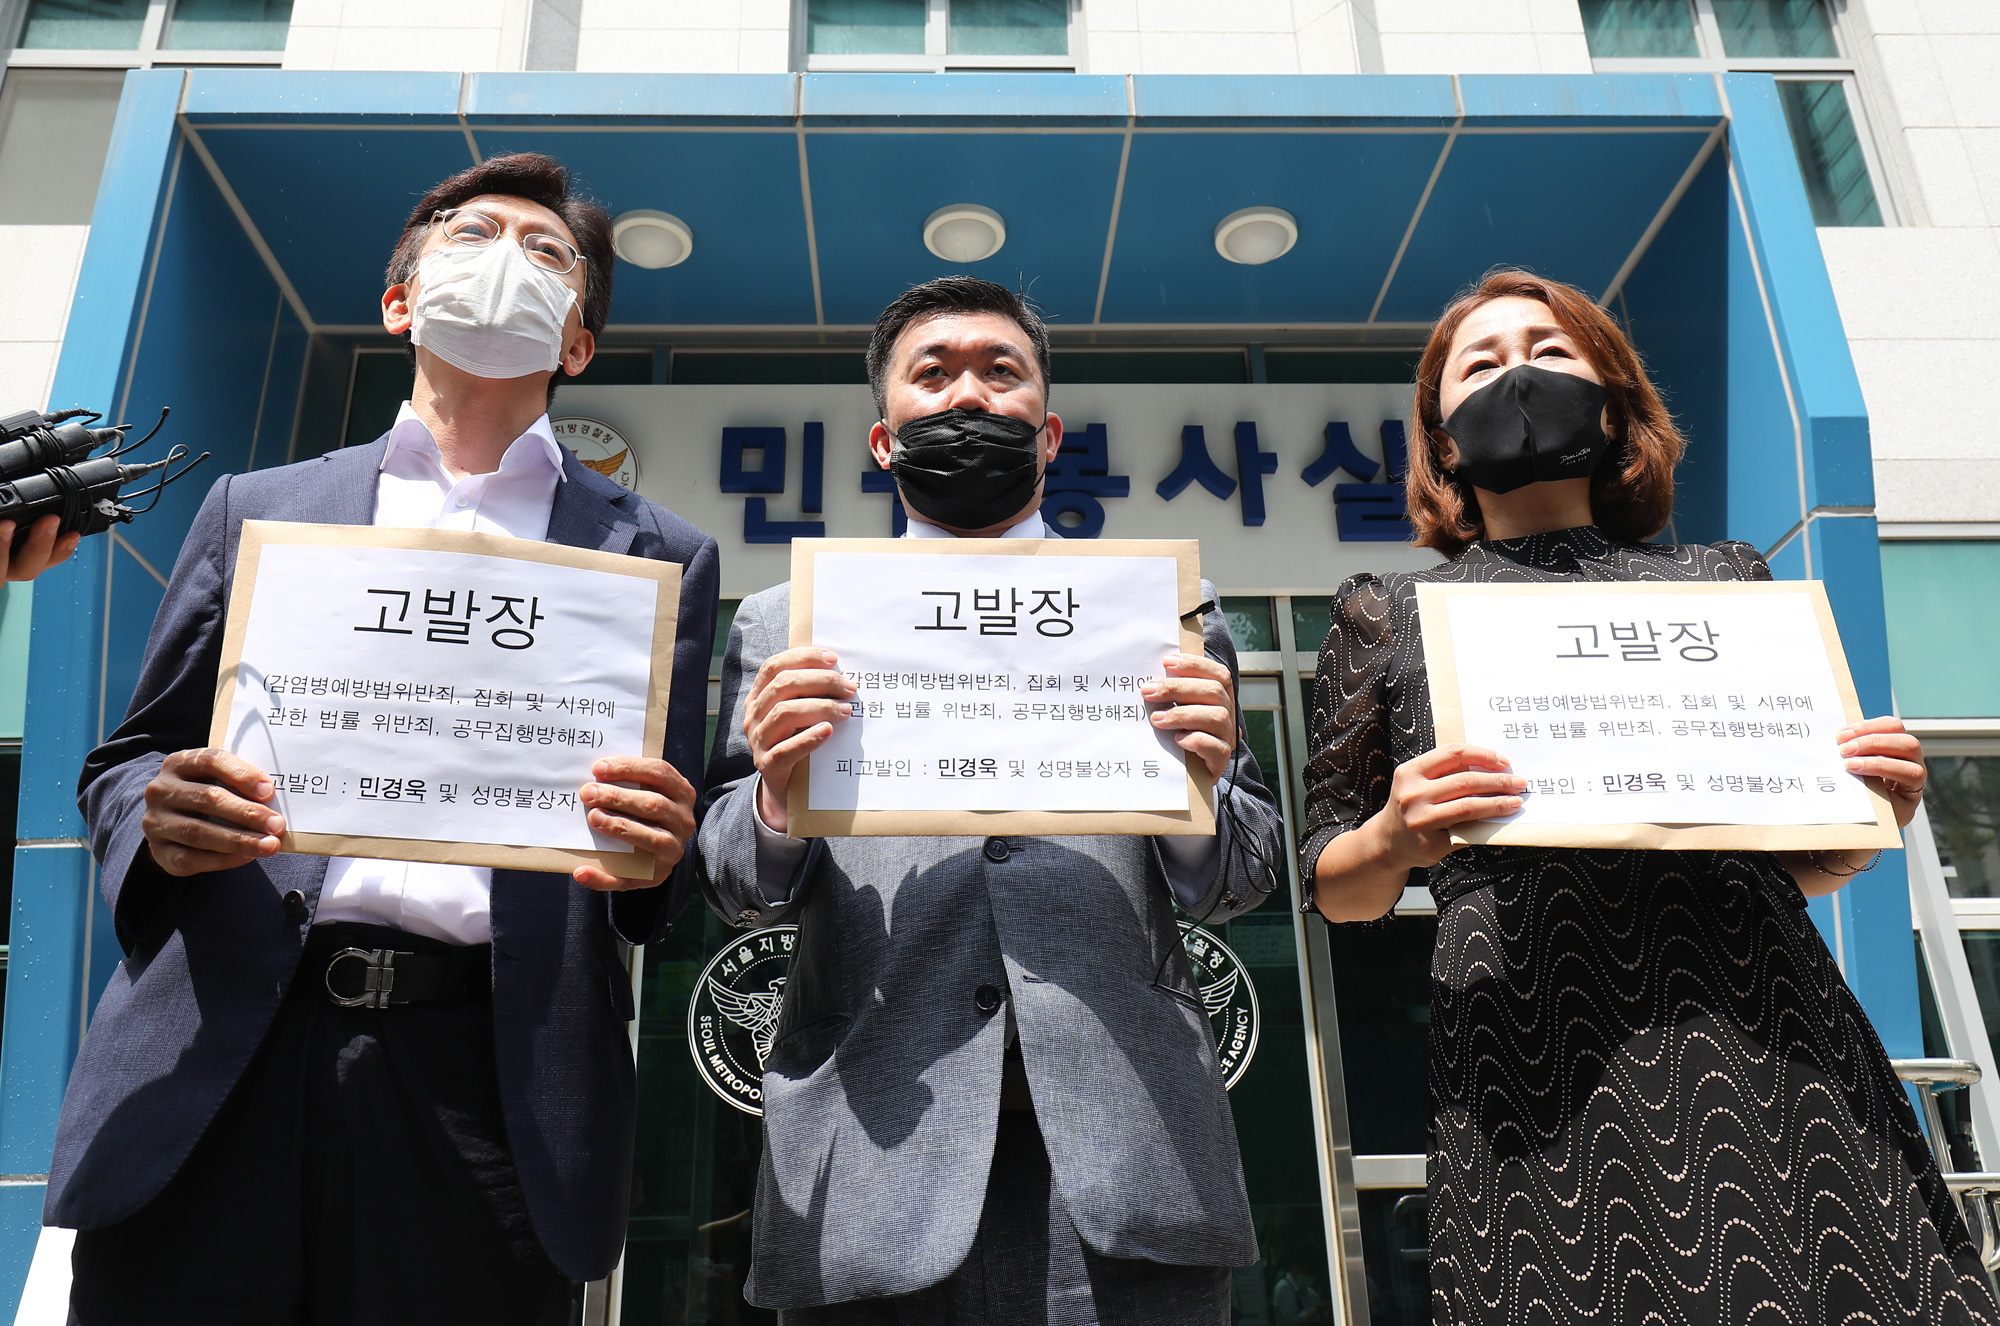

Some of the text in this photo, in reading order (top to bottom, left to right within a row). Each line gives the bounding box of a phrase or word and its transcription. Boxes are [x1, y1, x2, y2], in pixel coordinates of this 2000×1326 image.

[554, 424, 614, 444] 지방경찰청
[719, 420, 1418, 543] 민봉사실
[354, 588, 545, 650] 고발장
[915, 587, 1080, 637] 고발장
[1556, 620, 1720, 662] 고발장
[262, 674, 616, 720] (감염병예방법위반죄, 집회 및 시위에
[1026, 673, 1062, 692] 집회
[1073, 674, 1089, 692] 및
[1488, 694, 1814, 712] (감염병예방법위반죄, 집회 및 시위에
[266, 706, 605, 749] 관한 법률 위반죄, 공무집행방해죄)
[850, 701, 1147, 721] 관한 법률 위반죄, 공무집행방해죄)
[1502, 720, 1811, 739] 관한 법률 위반죄, 공무집행방해죄)
[835, 758, 911, 778] 피고발인
[938, 758, 998, 777] 민경욱
[1008, 760, 1025, 778] 및
[1036, 760, 1131, 779] 성명불상자
[1141, 760, 1161, 779] 등
[1520, 777, 1576, 794] 고발인
[1603, 773, 1667, 792] 민경욱
[1676, 774, 1696, 792] 및
[1707, 774, 1805, 793] 성명불상자
[1816, 776, 1837, 793] 등
[269, 773, 330, 795] 고발인
[359, 777, 427, 801] 민경욱
[439, 784, 459, 804] 및
[471, 784, 577, 812] 성명불상자
[721, 934, 796, 976] 서울지방
[1227, 1007, 1249, 1060] AGENCY
[700, 1015, 763, 1102] SEOUL METROPO
